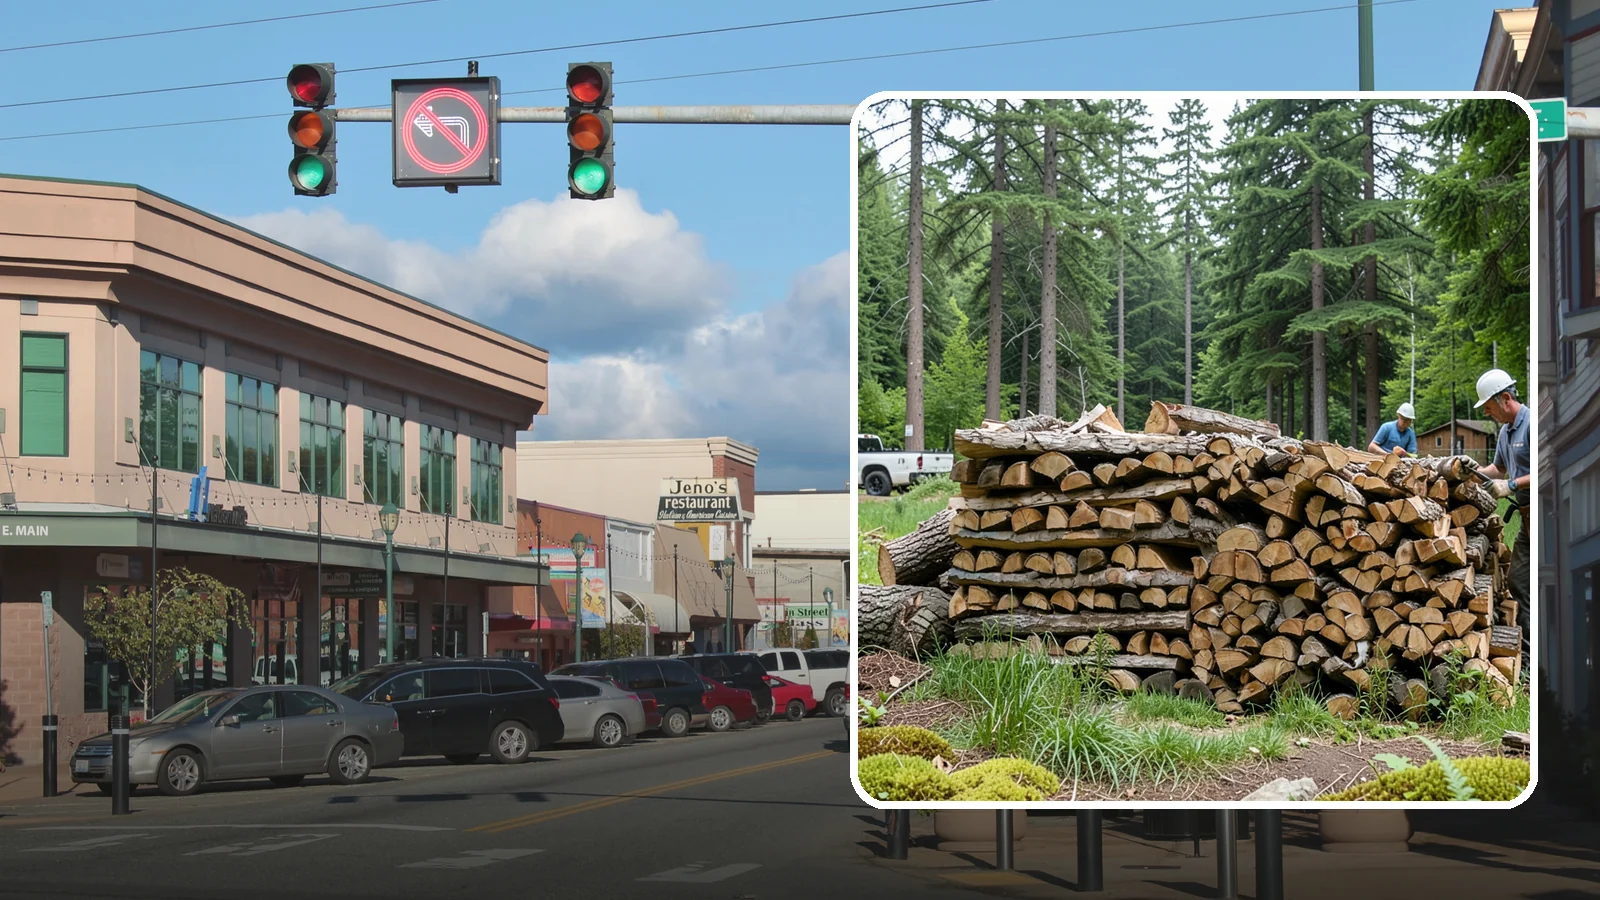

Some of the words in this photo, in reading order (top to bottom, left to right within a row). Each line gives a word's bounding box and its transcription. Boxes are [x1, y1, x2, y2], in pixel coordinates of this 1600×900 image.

[670, 480, 727, 494] Jeno's
[665, 496, 731, 509] restaurant
[659, 510, 681, 519] Italian
[686, 510, 714, 519] American
[715, 509, 737, 519] Cuisine
[2, 525, 13, 536] E.
[16, 525, 49, 536] MAIN
[797, 607, 828, 616] Street
